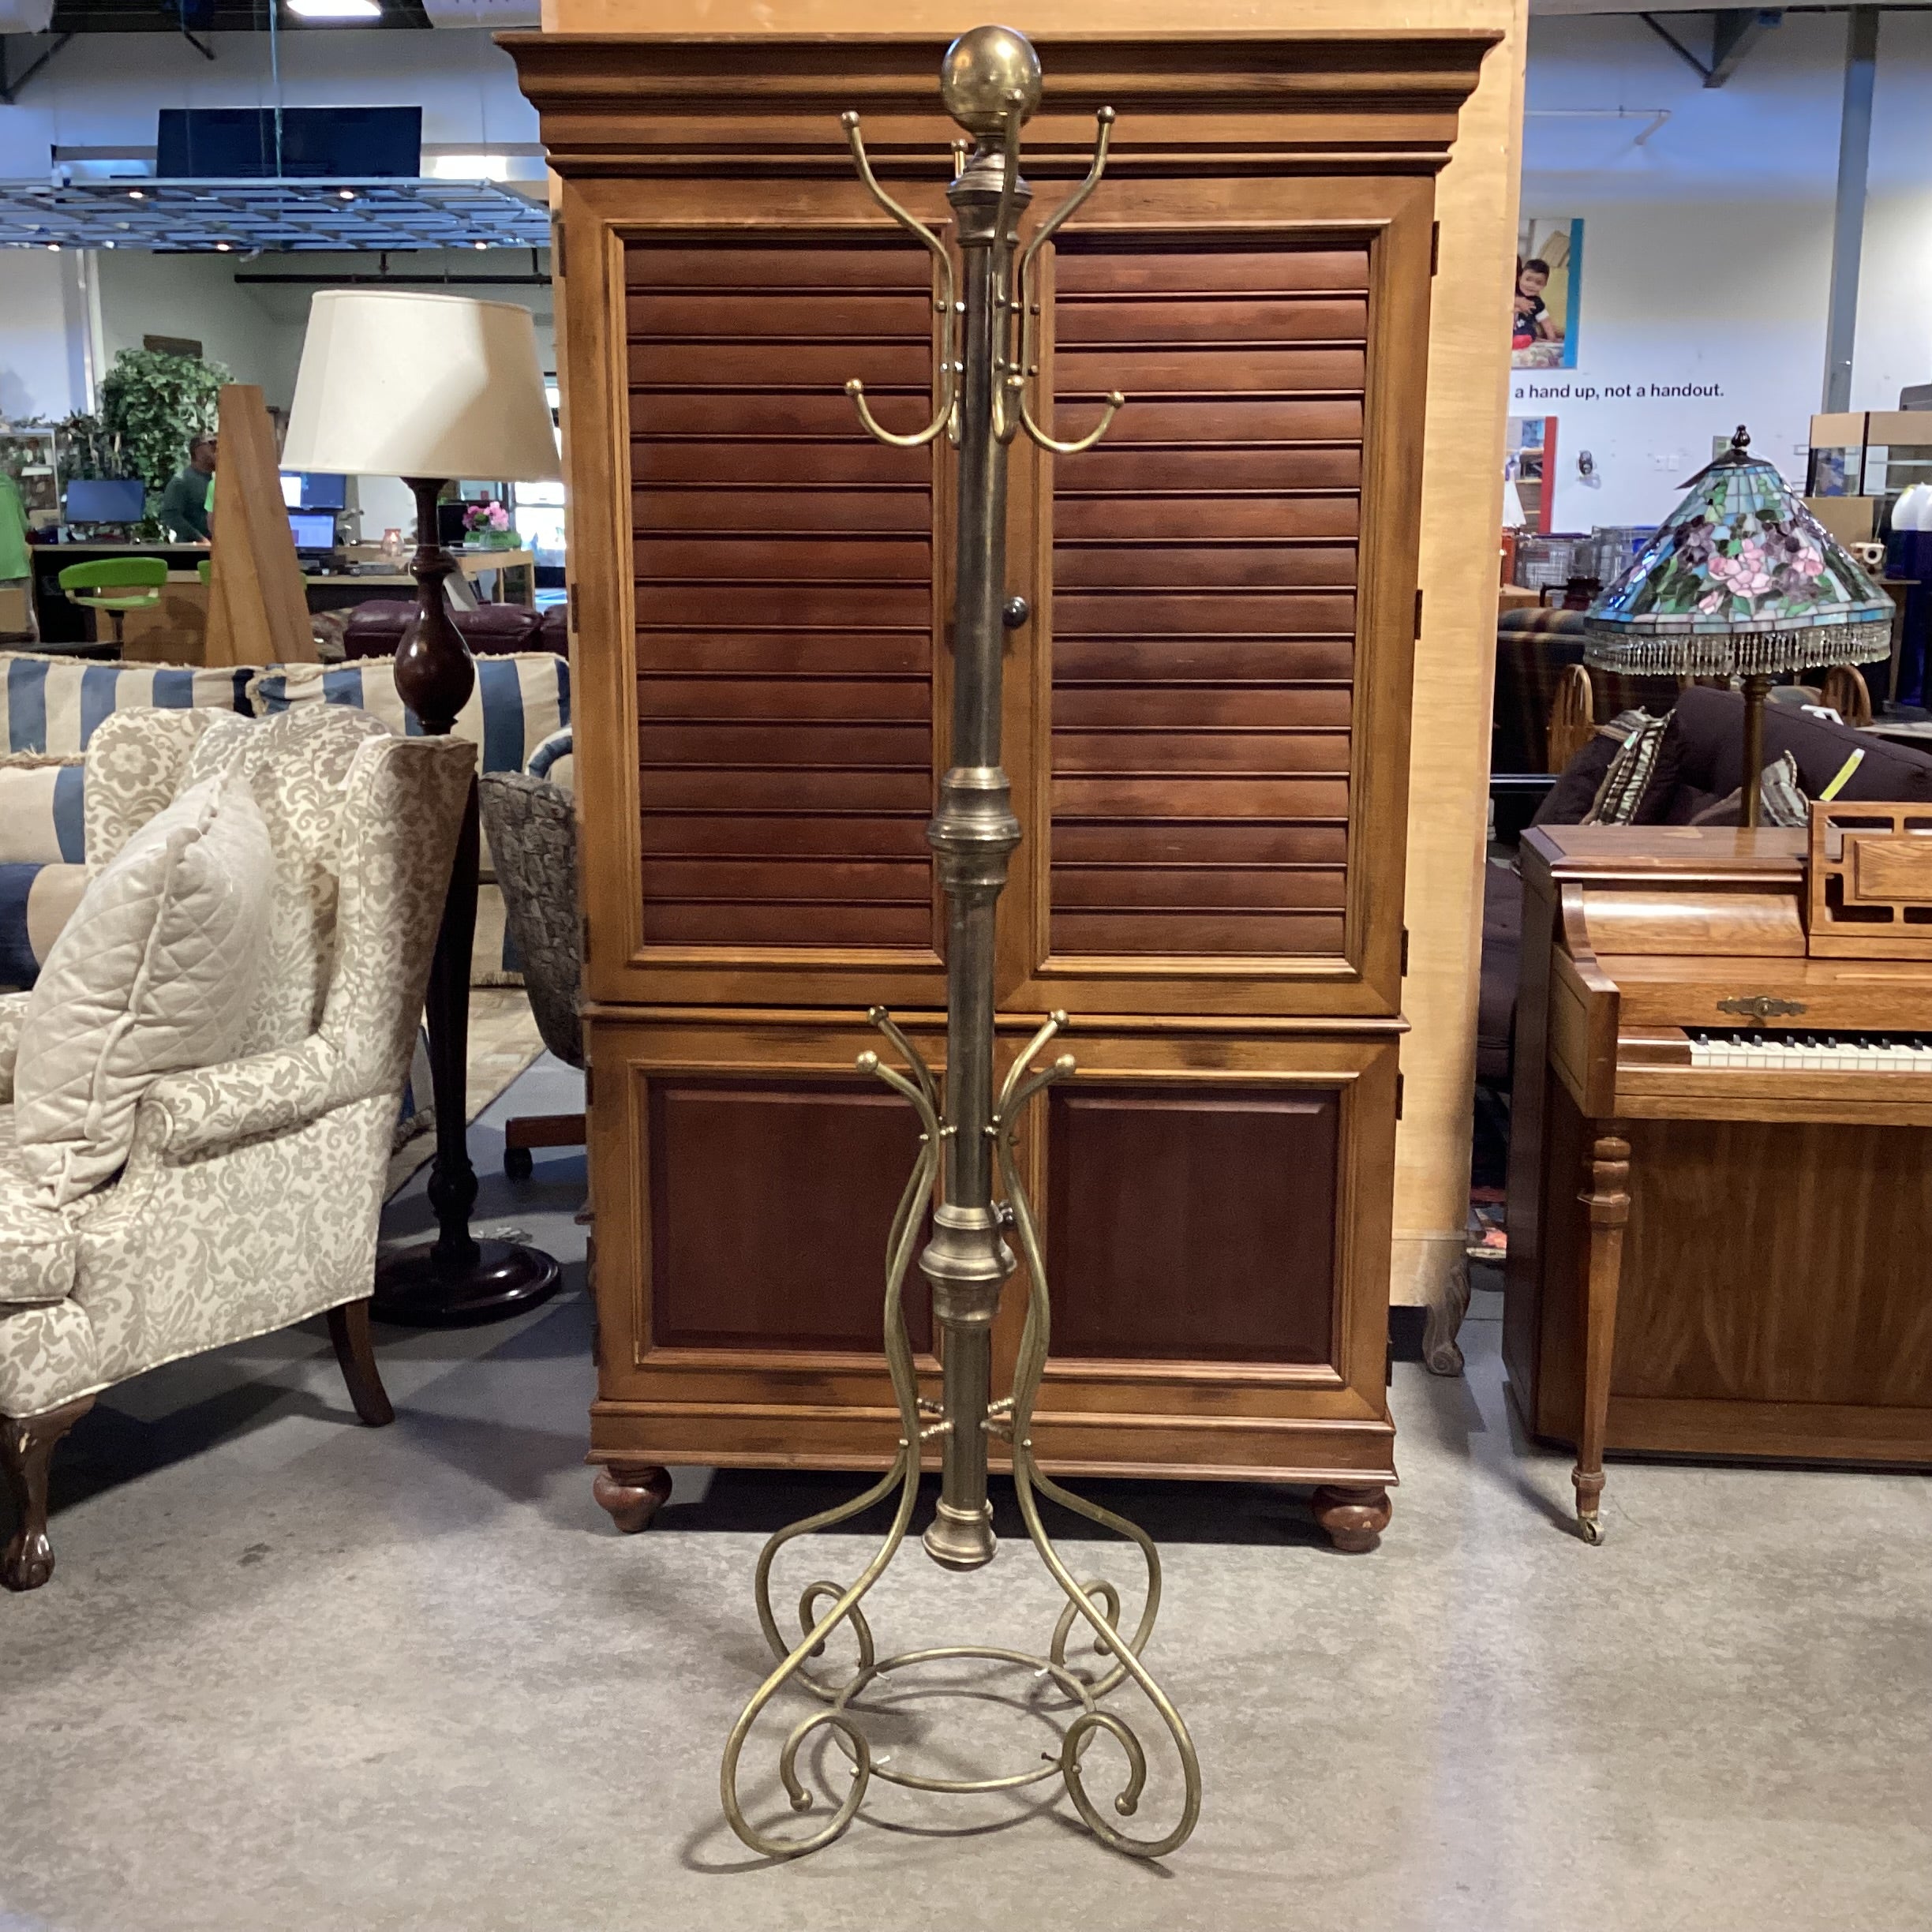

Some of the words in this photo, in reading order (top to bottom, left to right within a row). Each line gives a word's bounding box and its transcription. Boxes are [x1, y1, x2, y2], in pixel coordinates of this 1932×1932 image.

[1515, 388, 1524, 399] a
[1529, 384, 1571, 399] hand
[1574, 387, 1600, 401] up,
[1604, 384, 1631, 398] not
[1636, 387, 1646, 398] a
[1650, 383, 1724, 398] handout.
